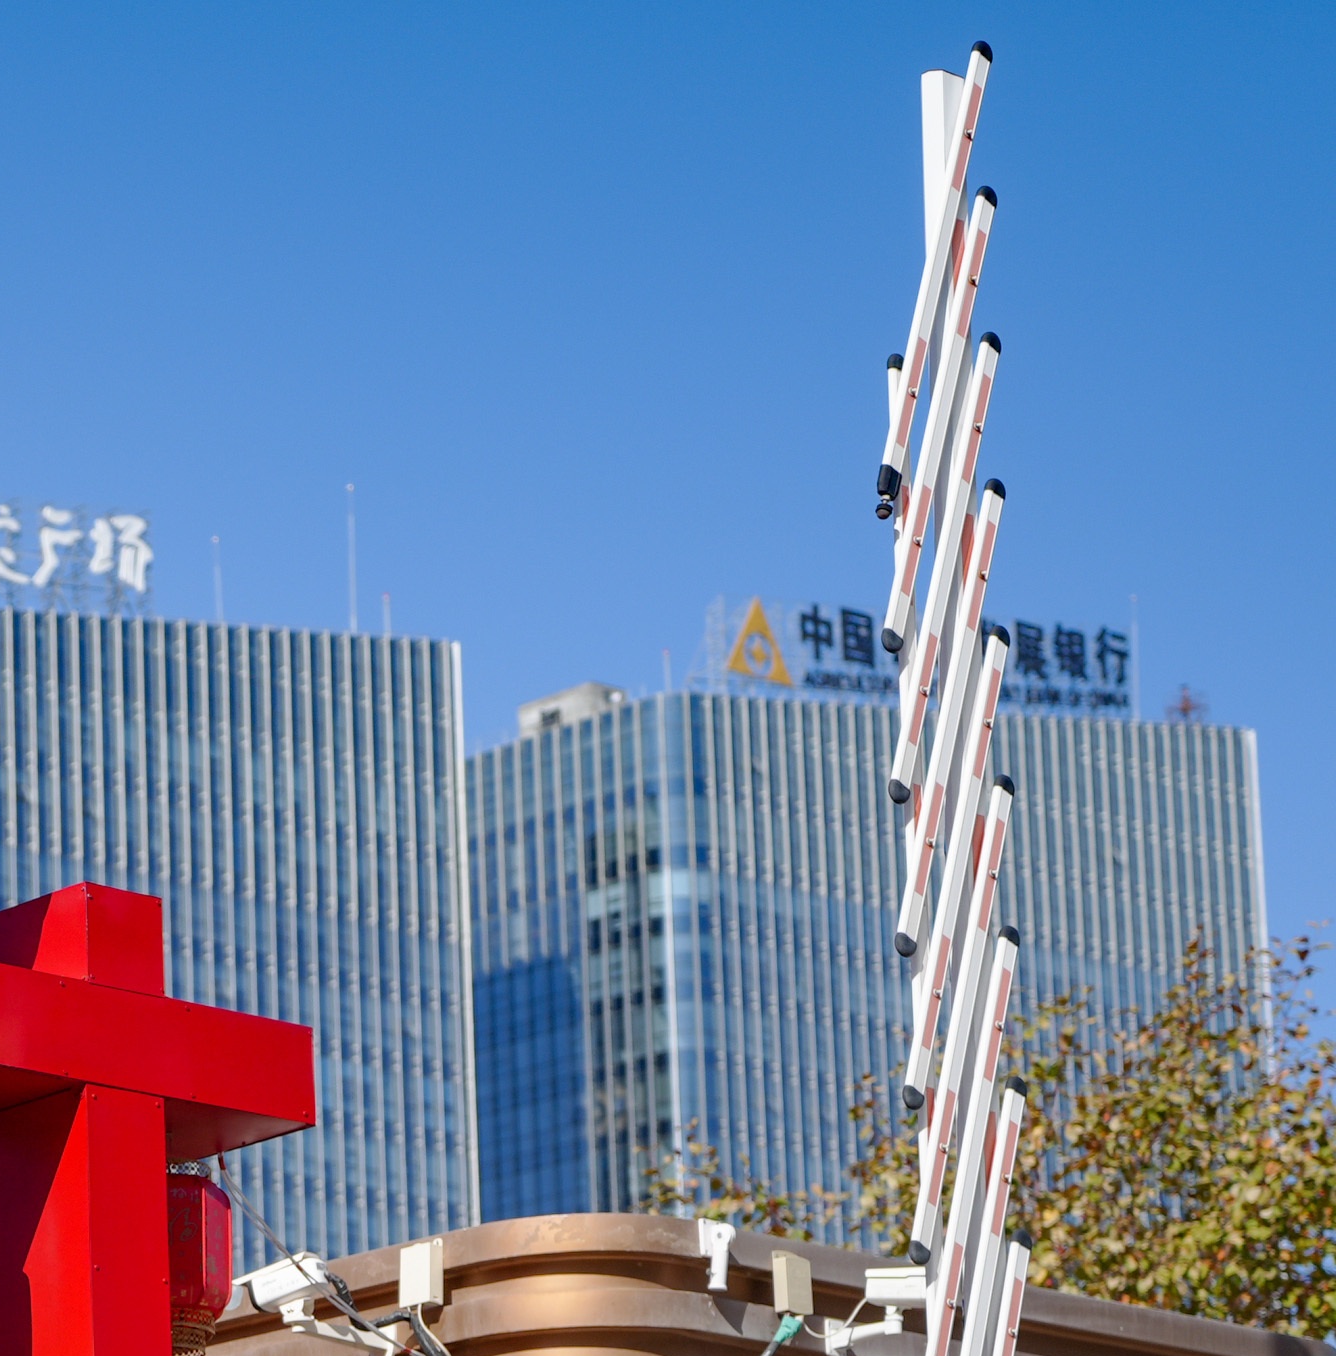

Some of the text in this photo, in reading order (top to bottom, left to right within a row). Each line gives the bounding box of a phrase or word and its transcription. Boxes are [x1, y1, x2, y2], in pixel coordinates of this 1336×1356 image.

[801, 603, 1129, 684] 中国展银行
